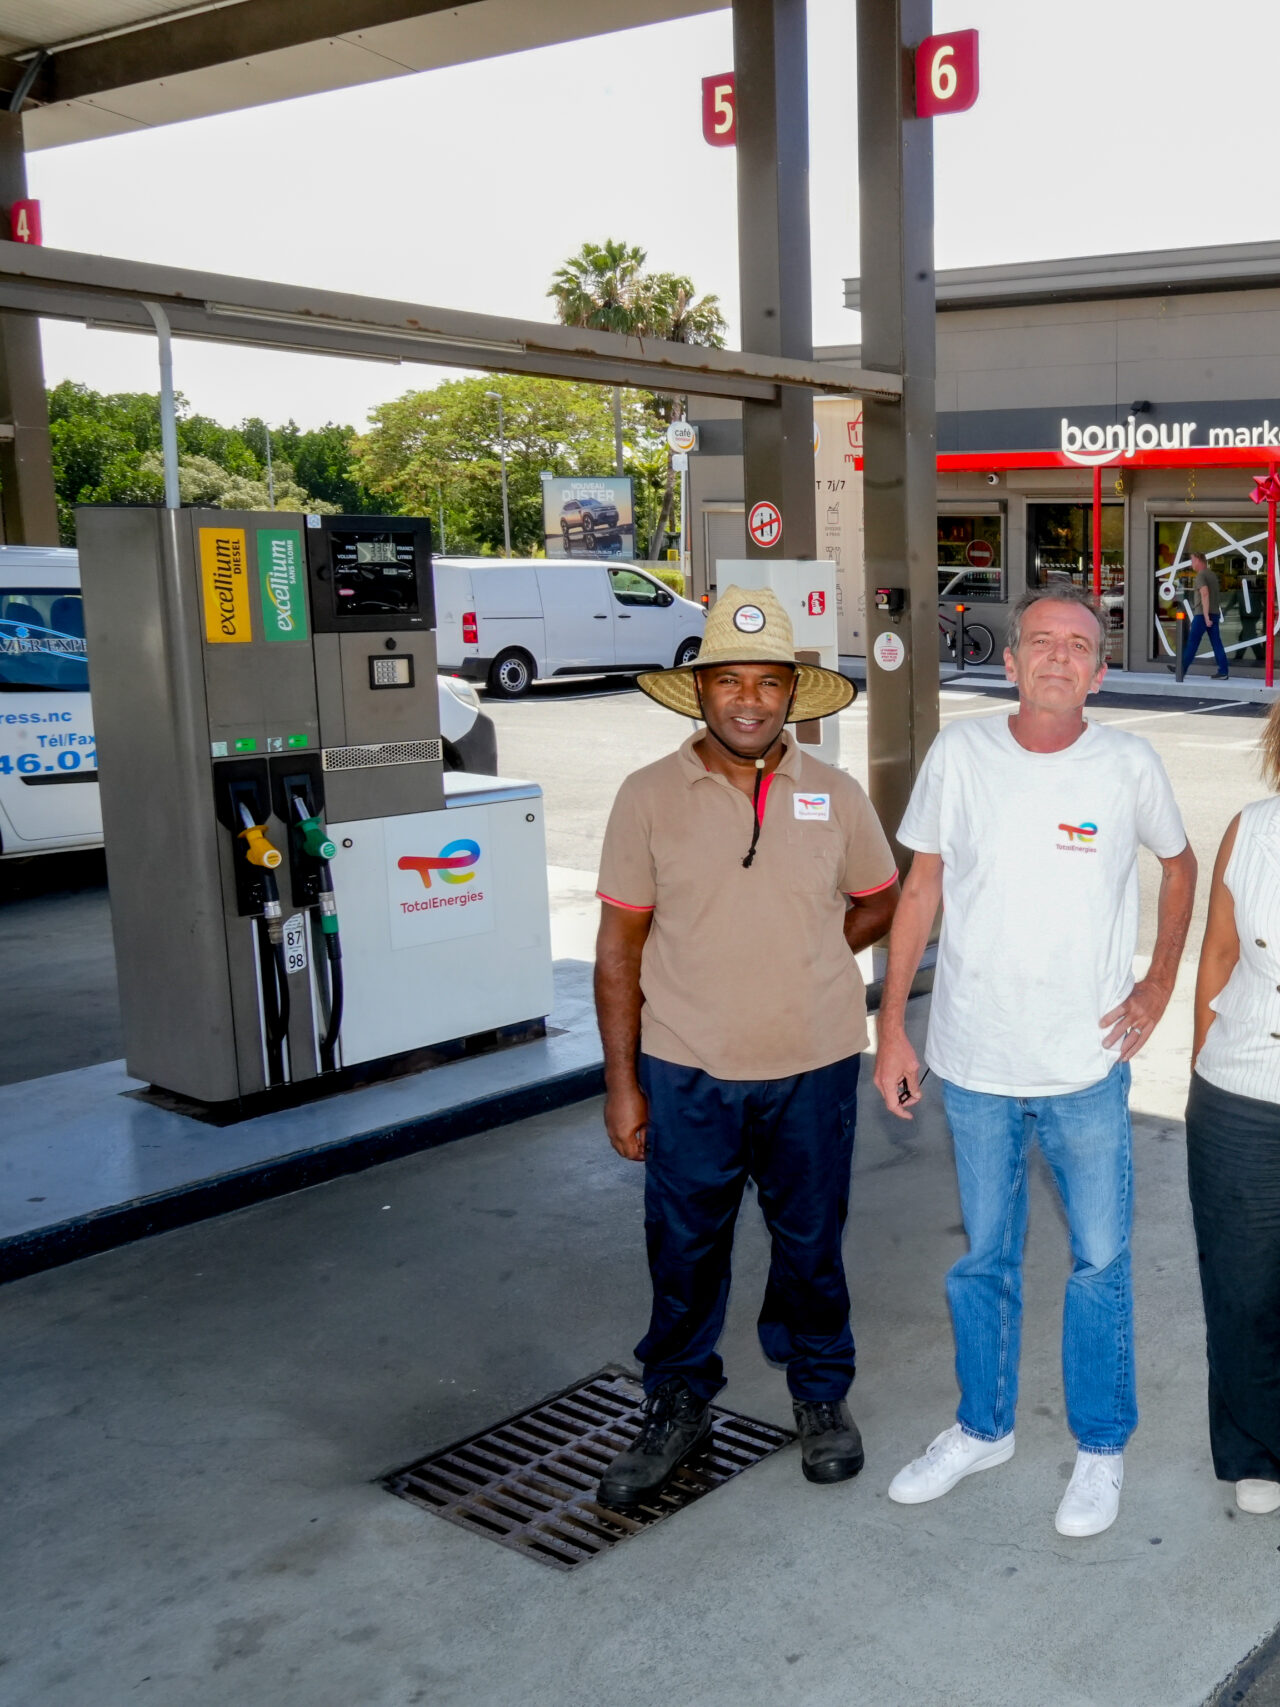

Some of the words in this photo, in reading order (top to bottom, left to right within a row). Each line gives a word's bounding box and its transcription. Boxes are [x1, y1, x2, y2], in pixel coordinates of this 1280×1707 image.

[931, 45, 957, 100] 6
[714, 84, 733, 134] 5
[17, 209, 30, 242] 4
[674, 428, 692, 437] café
[1061, 415, 1197, 458] bonjour
[562, 489, 615, 502] DUSTER
[827, 479, 846, 492] 7j/7
[232, 539, 242, 575] DIESEL
[286, 540, 295, 564] PLOMB
[270, 540, 292, 631] excellium
[288, 565, 297, 585] SANS
[213, 539, 236, 636] excellium
[1056, 843, 1097, 854] TotalEnergies
[400, 891, 484, 914] TotalEnergies
[287, 930, 301, 946] 87
[289, 953, 304, 969] 98
